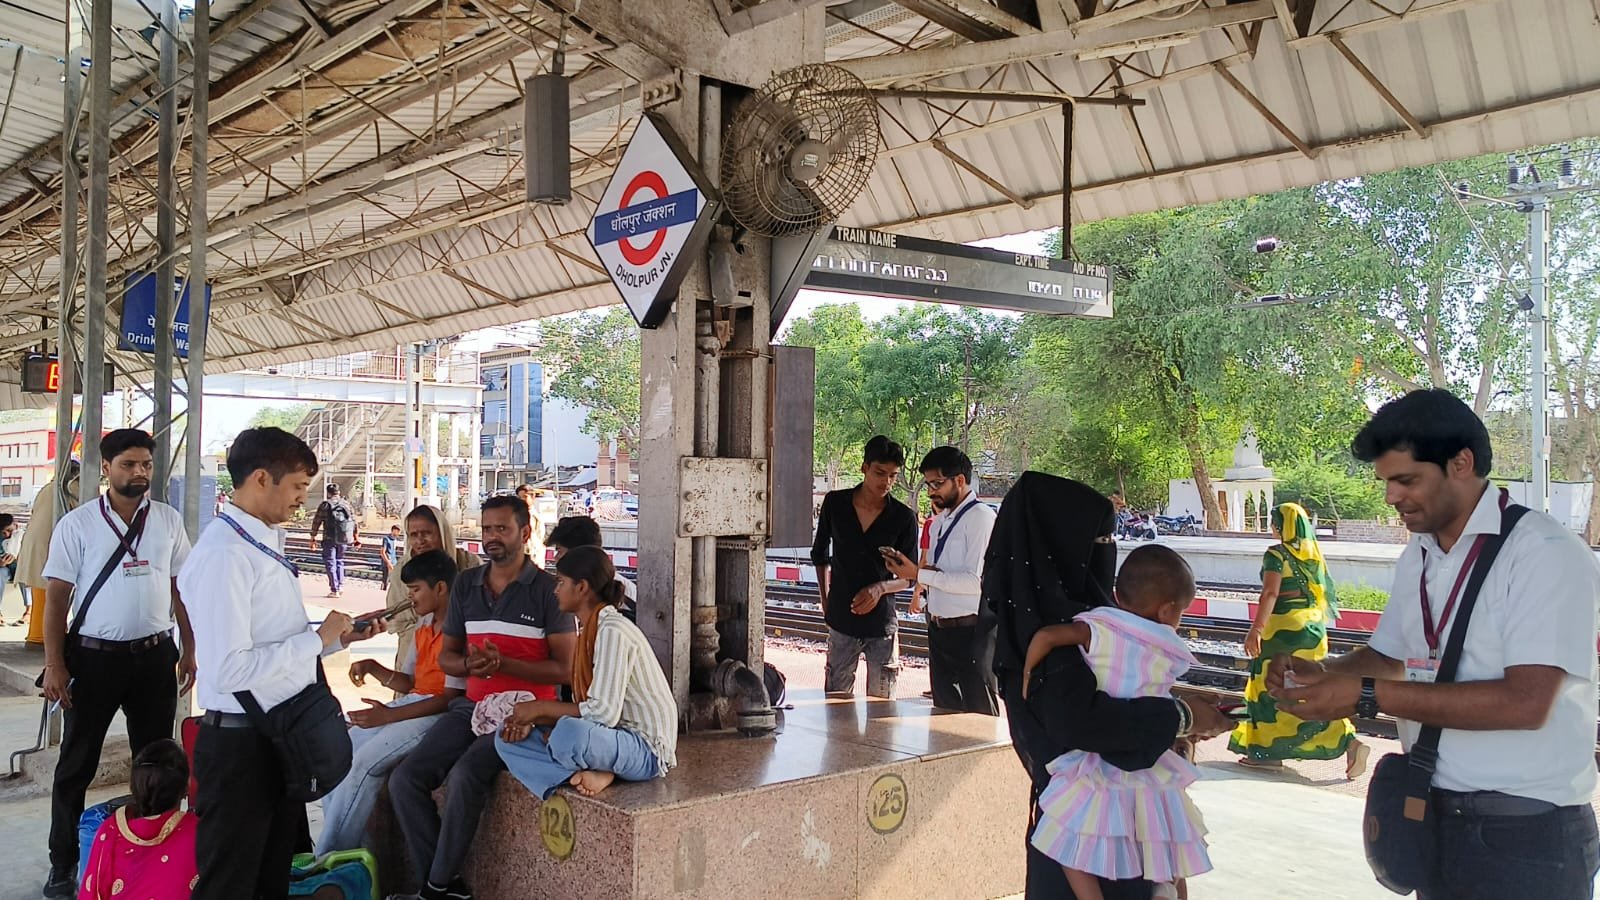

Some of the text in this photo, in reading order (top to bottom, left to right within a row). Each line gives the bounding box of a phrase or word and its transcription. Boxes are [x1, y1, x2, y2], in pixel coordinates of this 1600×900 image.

[610, 202, 677, 233] धौलपुर जंक्शन
[836, 226, 897, 248] TRAIN NAME
[615, 251, 674, 288] DHOLPUR JN.
[1034, 256, 1050, 270] TIME
[543, 806, 572, 842] 124
